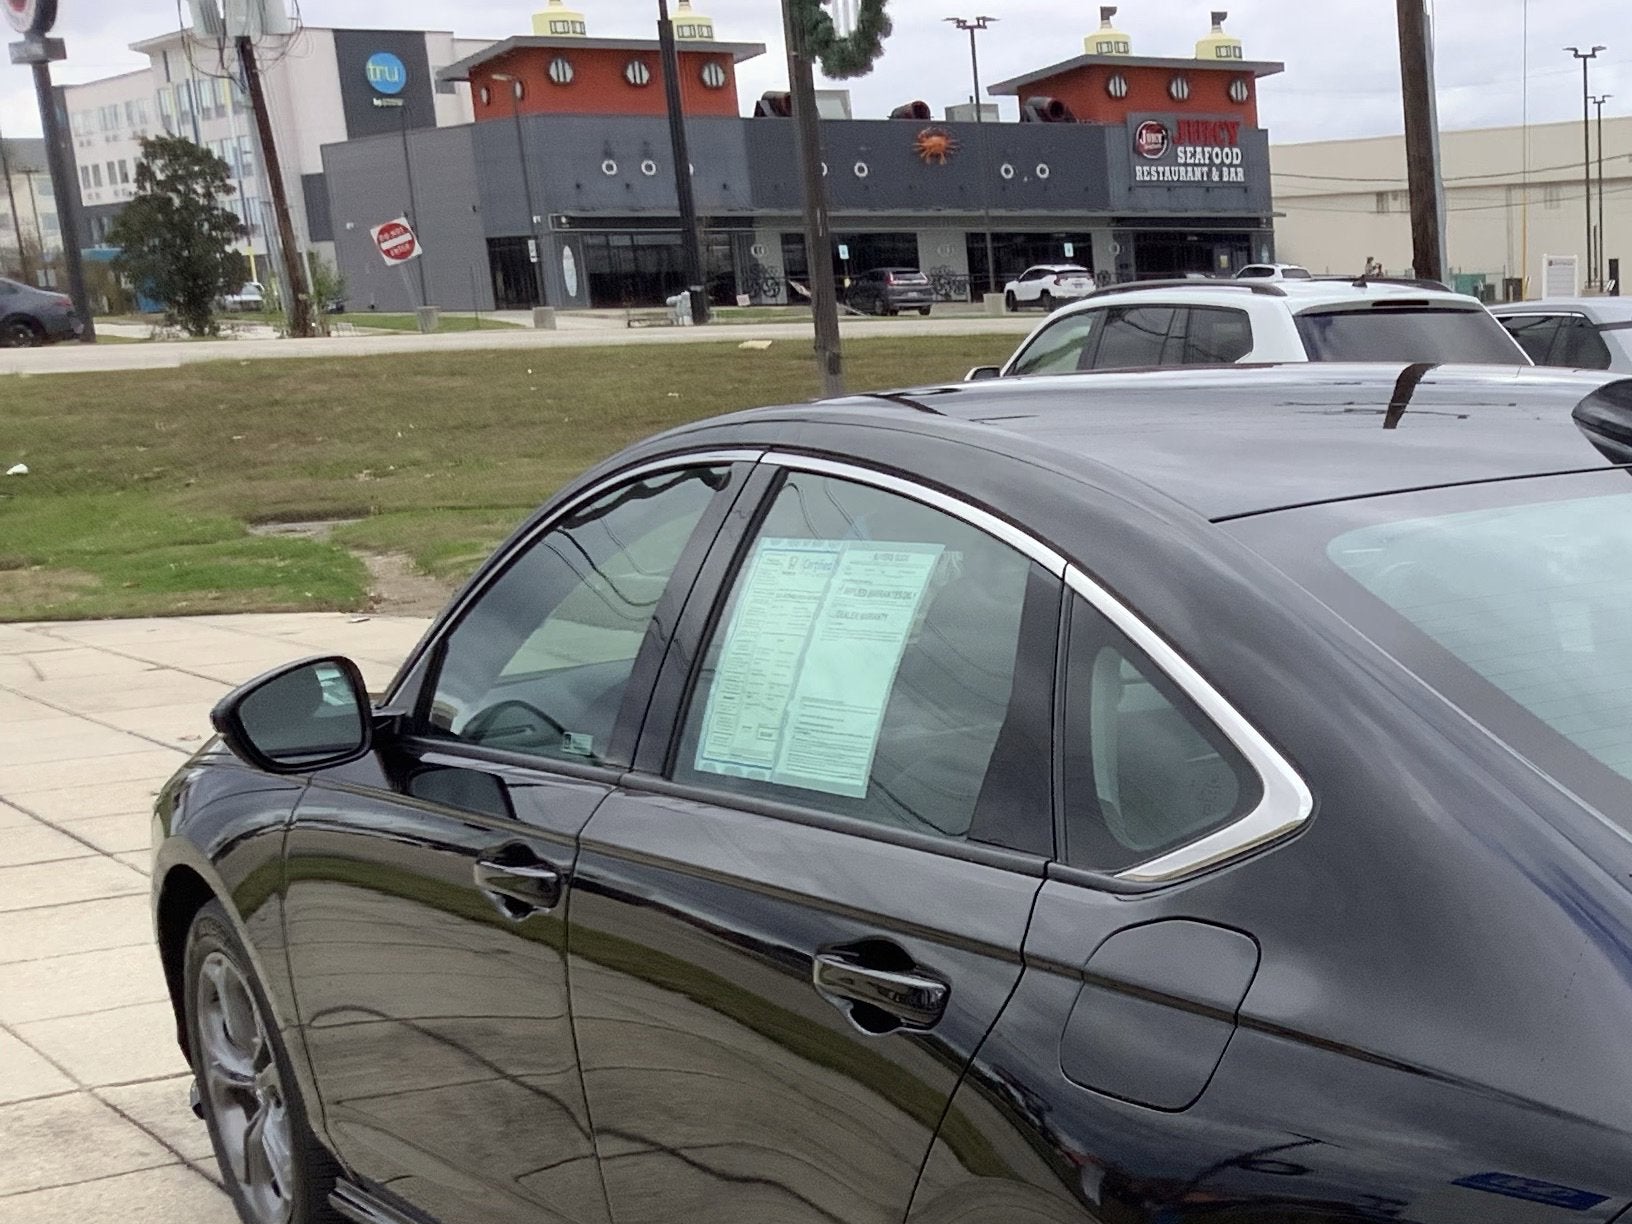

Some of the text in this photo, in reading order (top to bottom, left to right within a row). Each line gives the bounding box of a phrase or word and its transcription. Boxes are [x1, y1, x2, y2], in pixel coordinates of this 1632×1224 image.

[1172, 119, 1240, 145] JUICY
[1177, 146, 1242, 165] SEAFOOD
[1135, 165, 1245, 182] RESTAURANT & BAR
